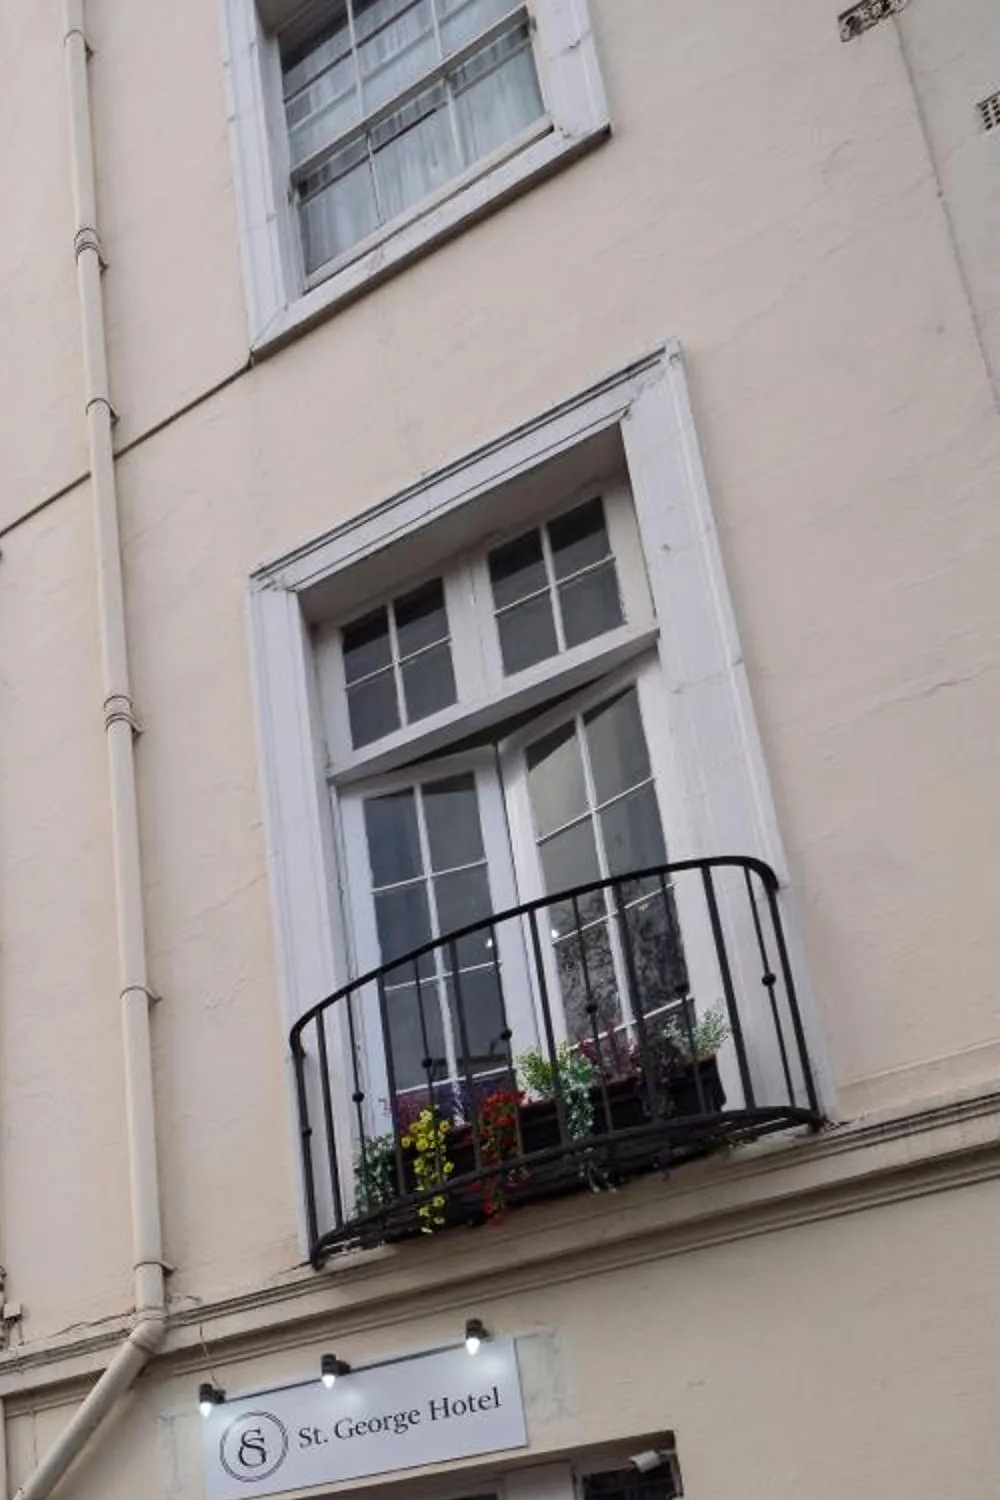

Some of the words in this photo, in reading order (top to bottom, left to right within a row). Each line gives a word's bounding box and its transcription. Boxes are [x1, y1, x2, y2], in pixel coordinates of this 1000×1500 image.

[298, 1426, 328, 1449] St.
[334, 1408, 421, 1441] George
[428, 1386, 503, 1422] Hotel
